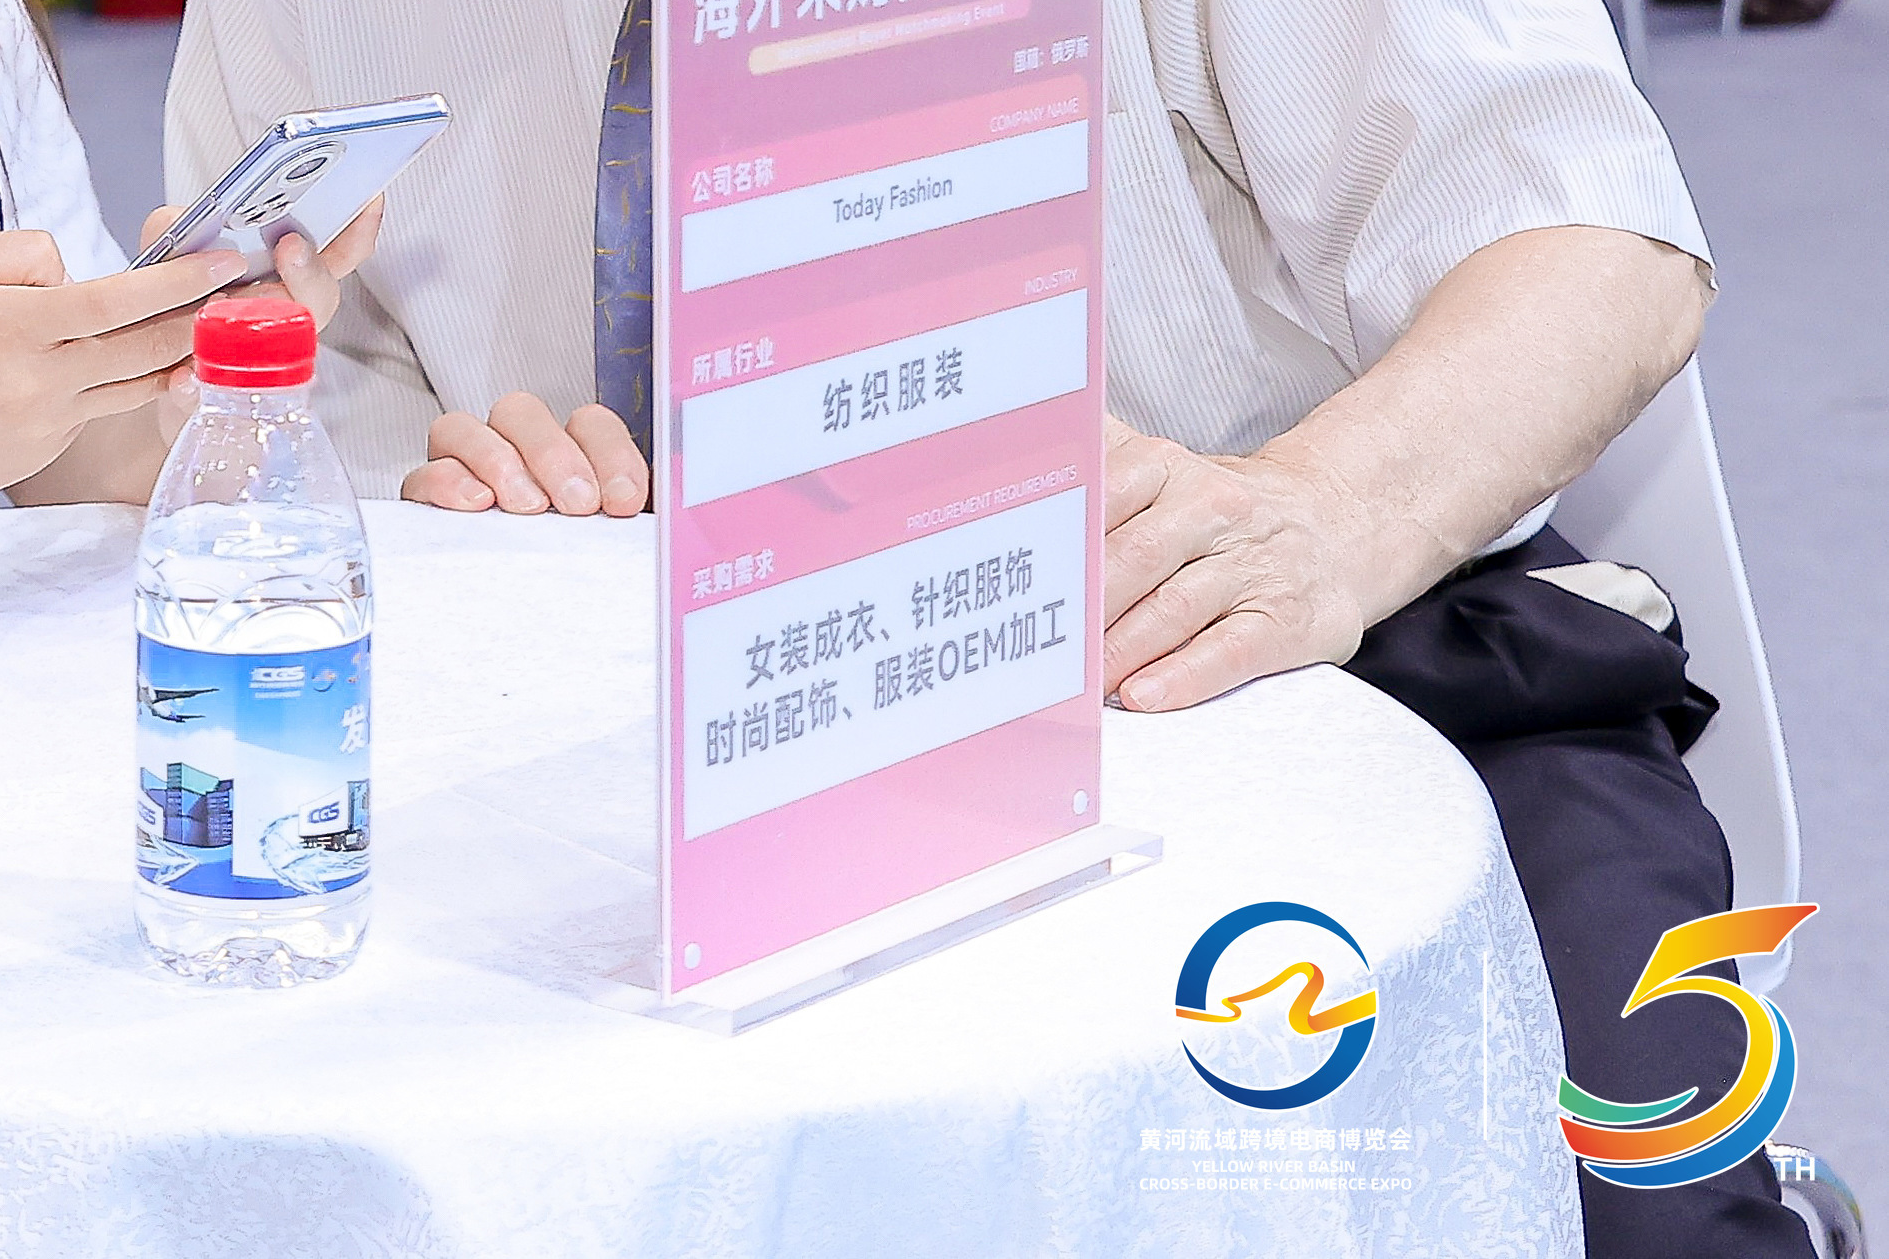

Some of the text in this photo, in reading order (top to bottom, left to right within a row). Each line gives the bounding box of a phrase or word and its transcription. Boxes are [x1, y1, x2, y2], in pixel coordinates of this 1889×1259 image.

[973, 3, 1005, 21] Event
[990, 97, 1079, 133] COMPANY NAME
[691, 156, 775, 203] 公司名称
[833, 176, 953, 224] Today Fashion
[1025, 267, 1079, 296] INDUSTRY
[691, 337, 776, 385] 所属行业
[823, 347, 964, 433] 纺织服装
[907, 465, 1078, 529] PROCUREMENT REQUIREMENTS
[691, 548, 775, 601] 采购需求
[745, 547, 1033, 689] 女装成衣、针织服饰
[706, 598, 1067, 767] 时尚配饰、服装OEM加工
